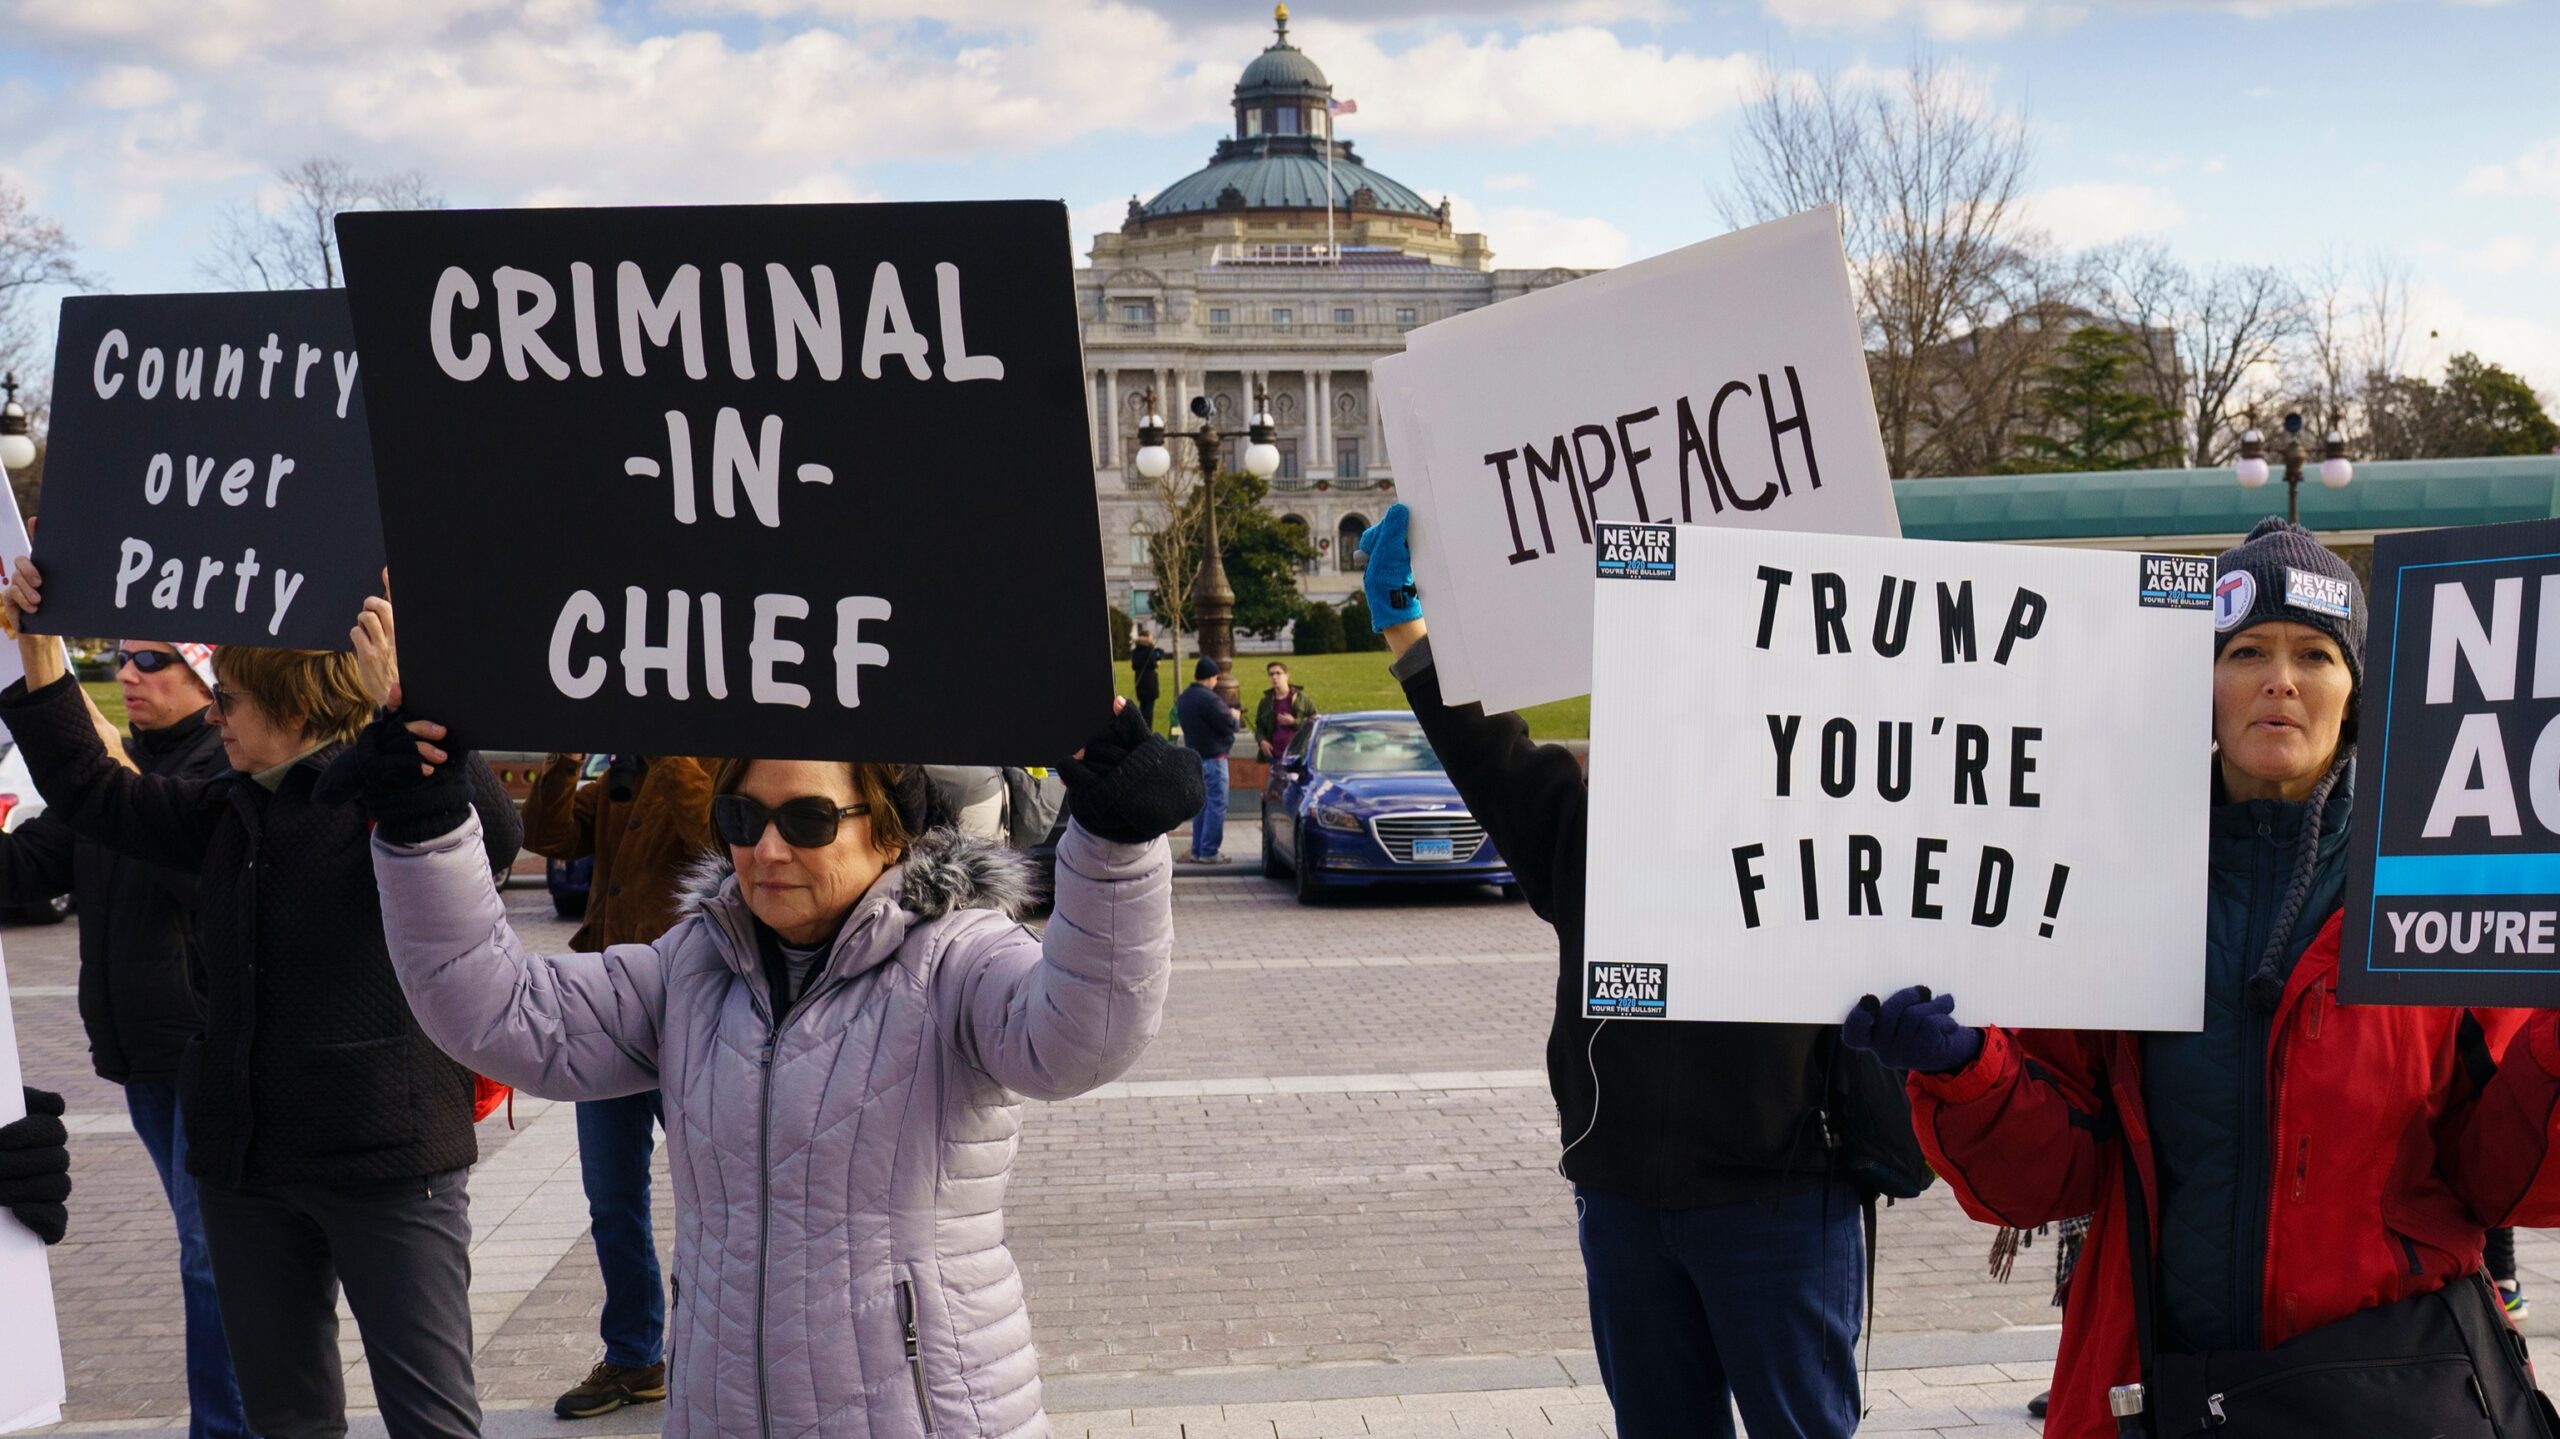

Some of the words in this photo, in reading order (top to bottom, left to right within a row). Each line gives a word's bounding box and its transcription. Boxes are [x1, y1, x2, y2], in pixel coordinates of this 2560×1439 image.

[431, 261, 1004, 382] CRIMINAL
[94, 329, 358, 418] Country
[145, 453, 294, 507] over
[625, 407, 833, 527] -IN-
[1485, 366, 1821, 565] IMPEACH
[1604, 529, 1670, 547] NEVER
[1605, 545, 1667, 562] AGAIN
[1628, 561, 1645, 569] 2020
[2147, 560, 2209, 577] NEVER
[115, 537, 304, 634] Party
[2147, 575, 2206, 593] AGAIN
[2169, 591, 2185, 599] 2020
[2290, 571, 2347, 595] NEVER
[2292, 584, 2344, 606] AGAIN
[1756, 566, 2047, 665] TRUMP
[549, 586, 891, 708] CHIEF
[1767, 715, 2042, 807] YOU'RE
[1732, 835, 2070, 938] FIRED!
[2387, 911, 2557, 953] YOU'RE
[1595, 967, 1661, 984] NEVER
[1596, 982, 1658, 999] AGAIN
[1618, 999, 1636, 1007] 2020
